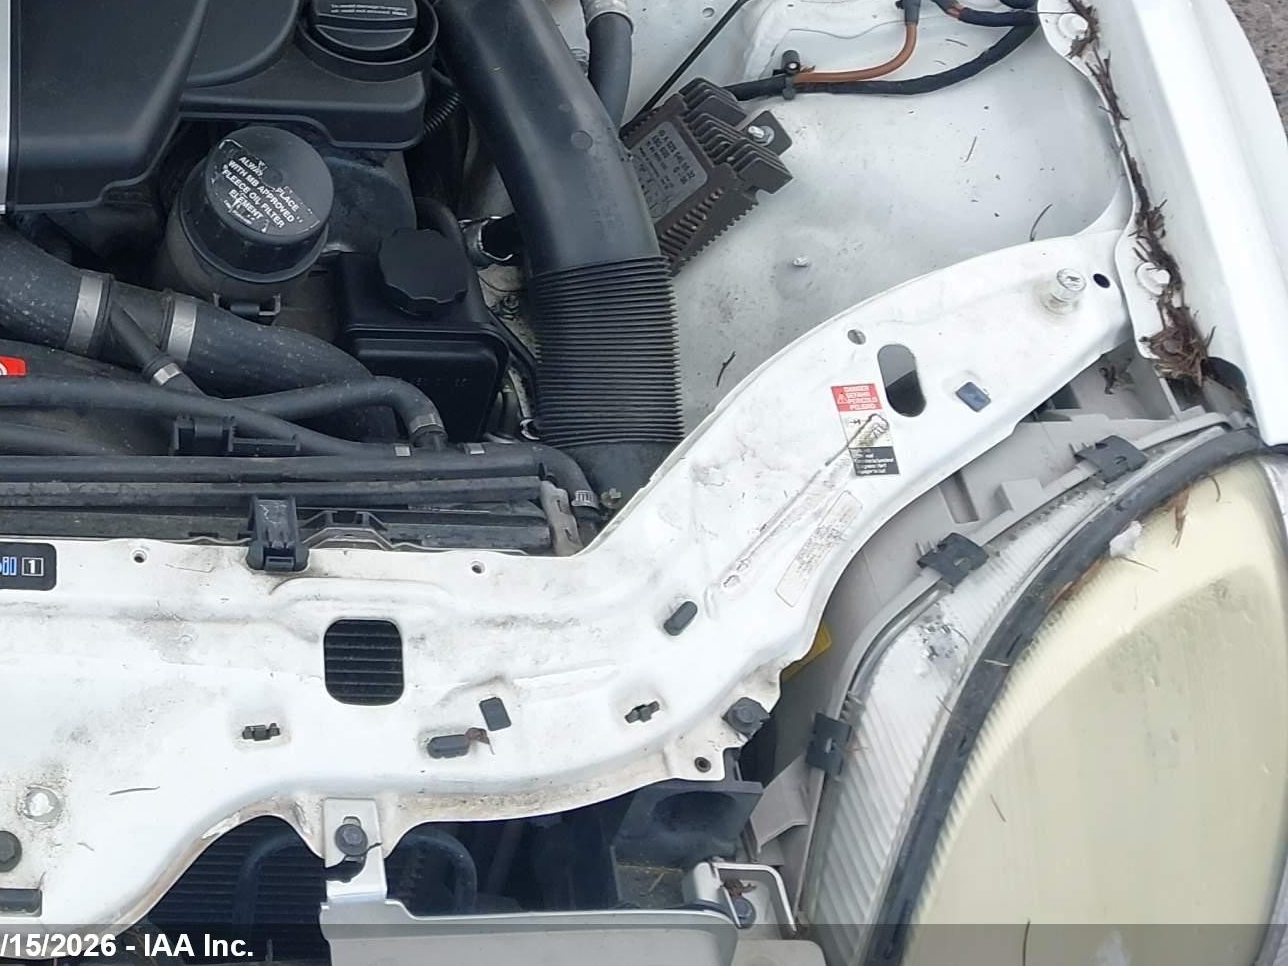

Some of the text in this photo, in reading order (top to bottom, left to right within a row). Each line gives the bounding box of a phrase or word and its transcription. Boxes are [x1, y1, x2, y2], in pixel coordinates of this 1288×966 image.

[228, 160, 249, 178] WITH
[245, 174, 259, 187] MB
[229, 189, 264, 219] ELEMENT
[249, 192, 262, 205] OIL
[261, 202, 286, 228] FILTER
